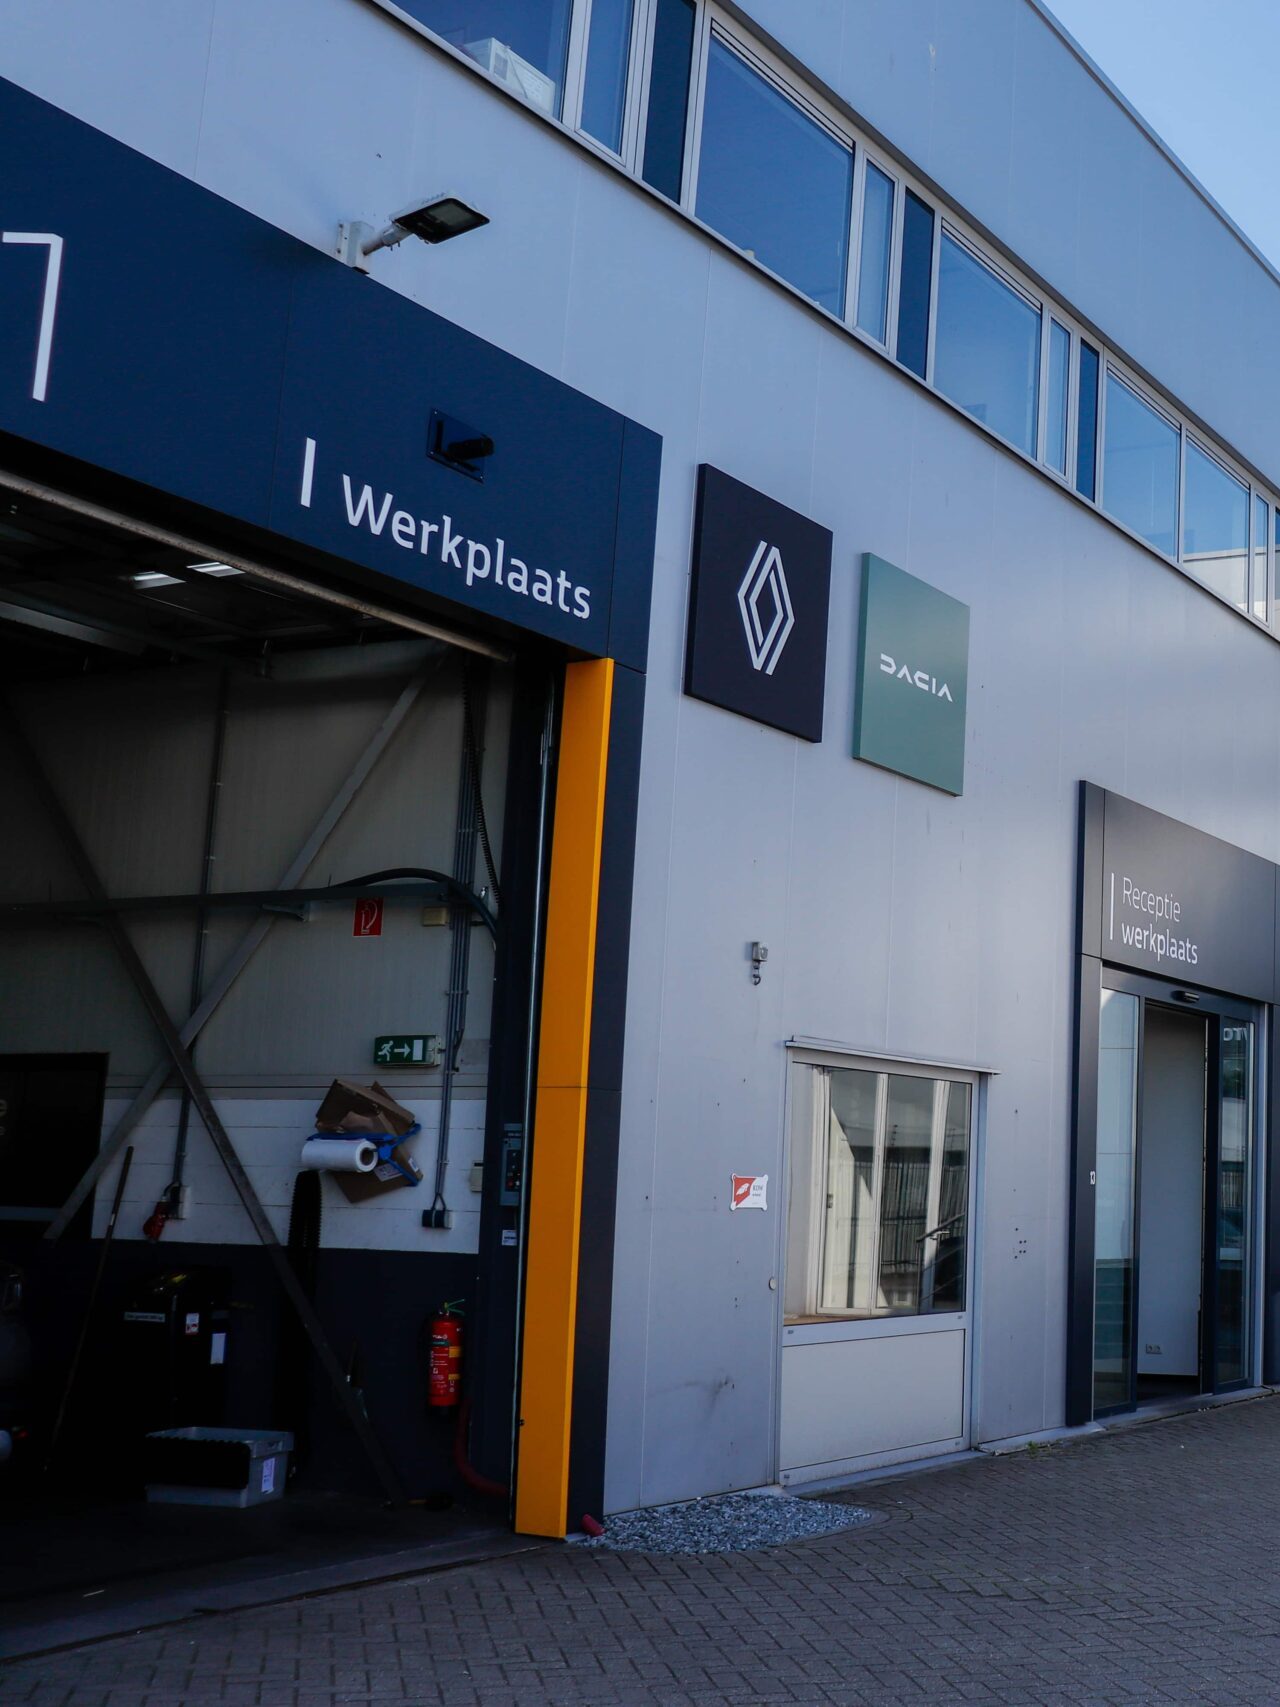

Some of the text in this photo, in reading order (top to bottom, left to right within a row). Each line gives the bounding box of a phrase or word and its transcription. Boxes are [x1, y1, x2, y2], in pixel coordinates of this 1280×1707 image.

[342, 473, 591, 620] Werkplaats
[880, 652, 953, 703] DACIA
[1123, 877, 1181, 922] Receptie
[1121, 922, 1198, 964] werkplaats
